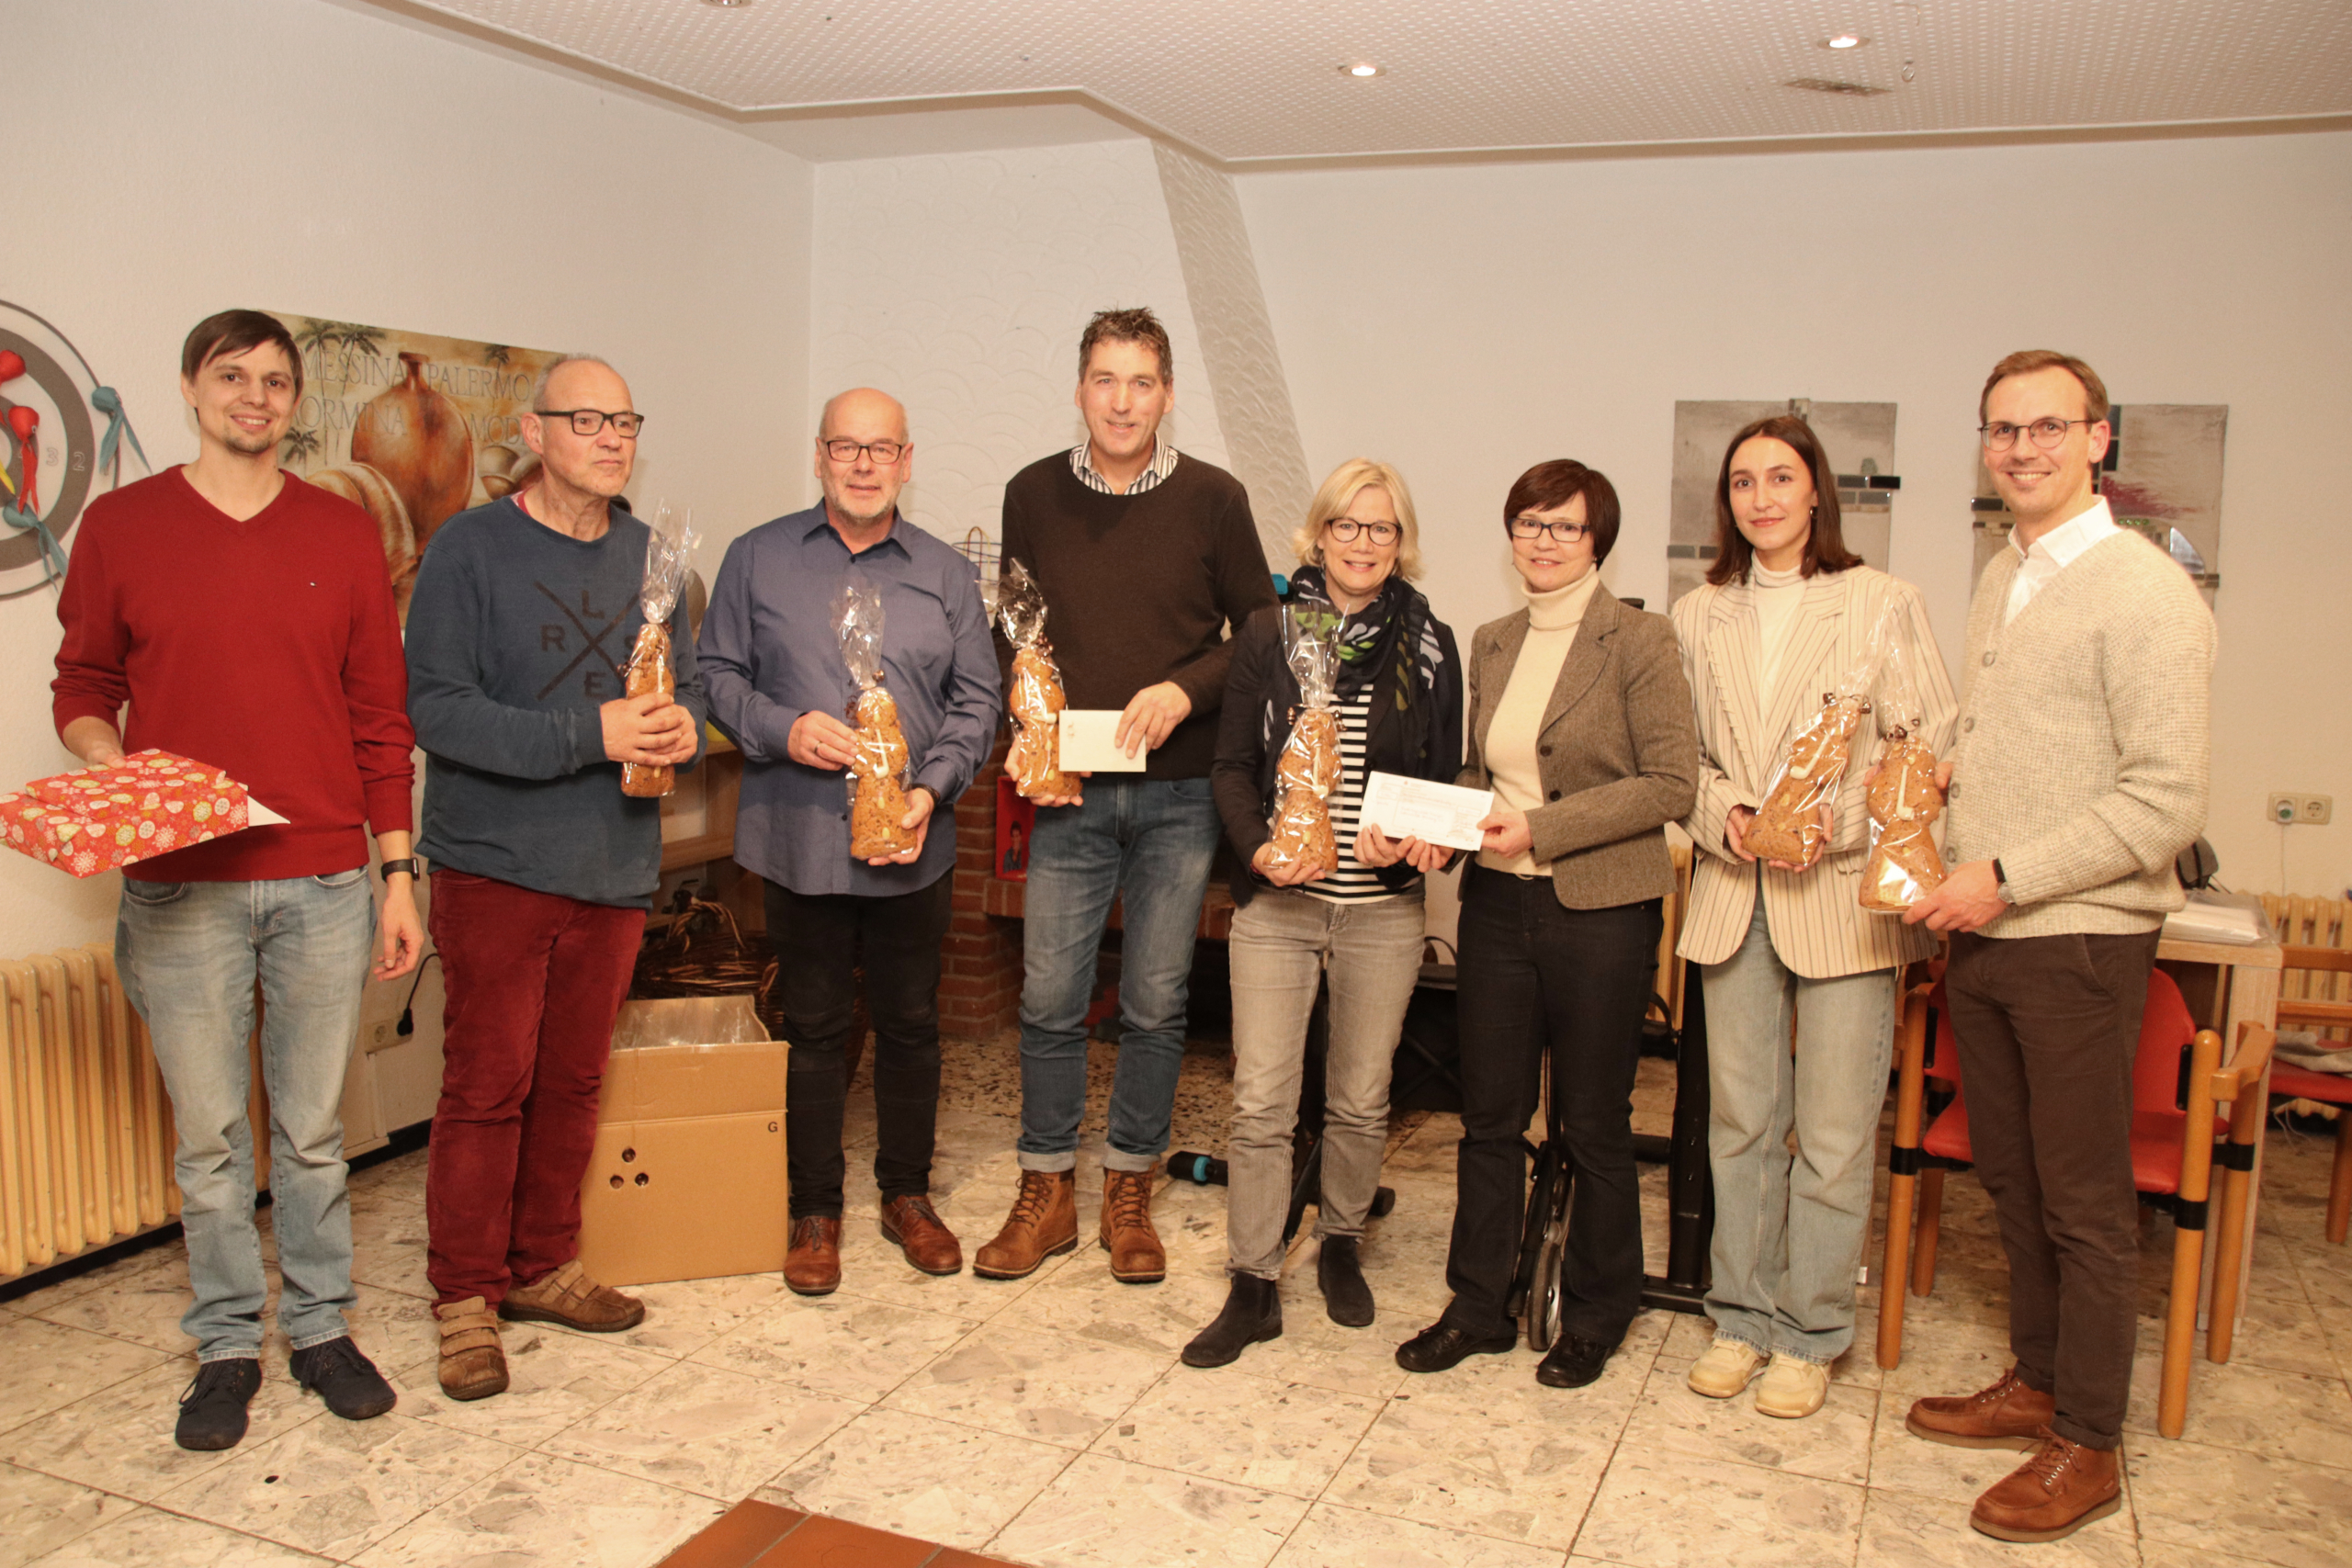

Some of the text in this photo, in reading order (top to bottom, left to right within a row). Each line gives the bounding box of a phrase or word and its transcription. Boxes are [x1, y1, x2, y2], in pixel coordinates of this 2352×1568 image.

[299, 348, 530, 401] MESSINA PALERMO
[470, 412, 527, 446] MOD
[46, 446, 85, 471] 3 2
[581, 589, 605, 619] L
[540, 624, 566, 652] R
[583, 671, 609, 698] E
[767, 1121, 778, 1133] G
